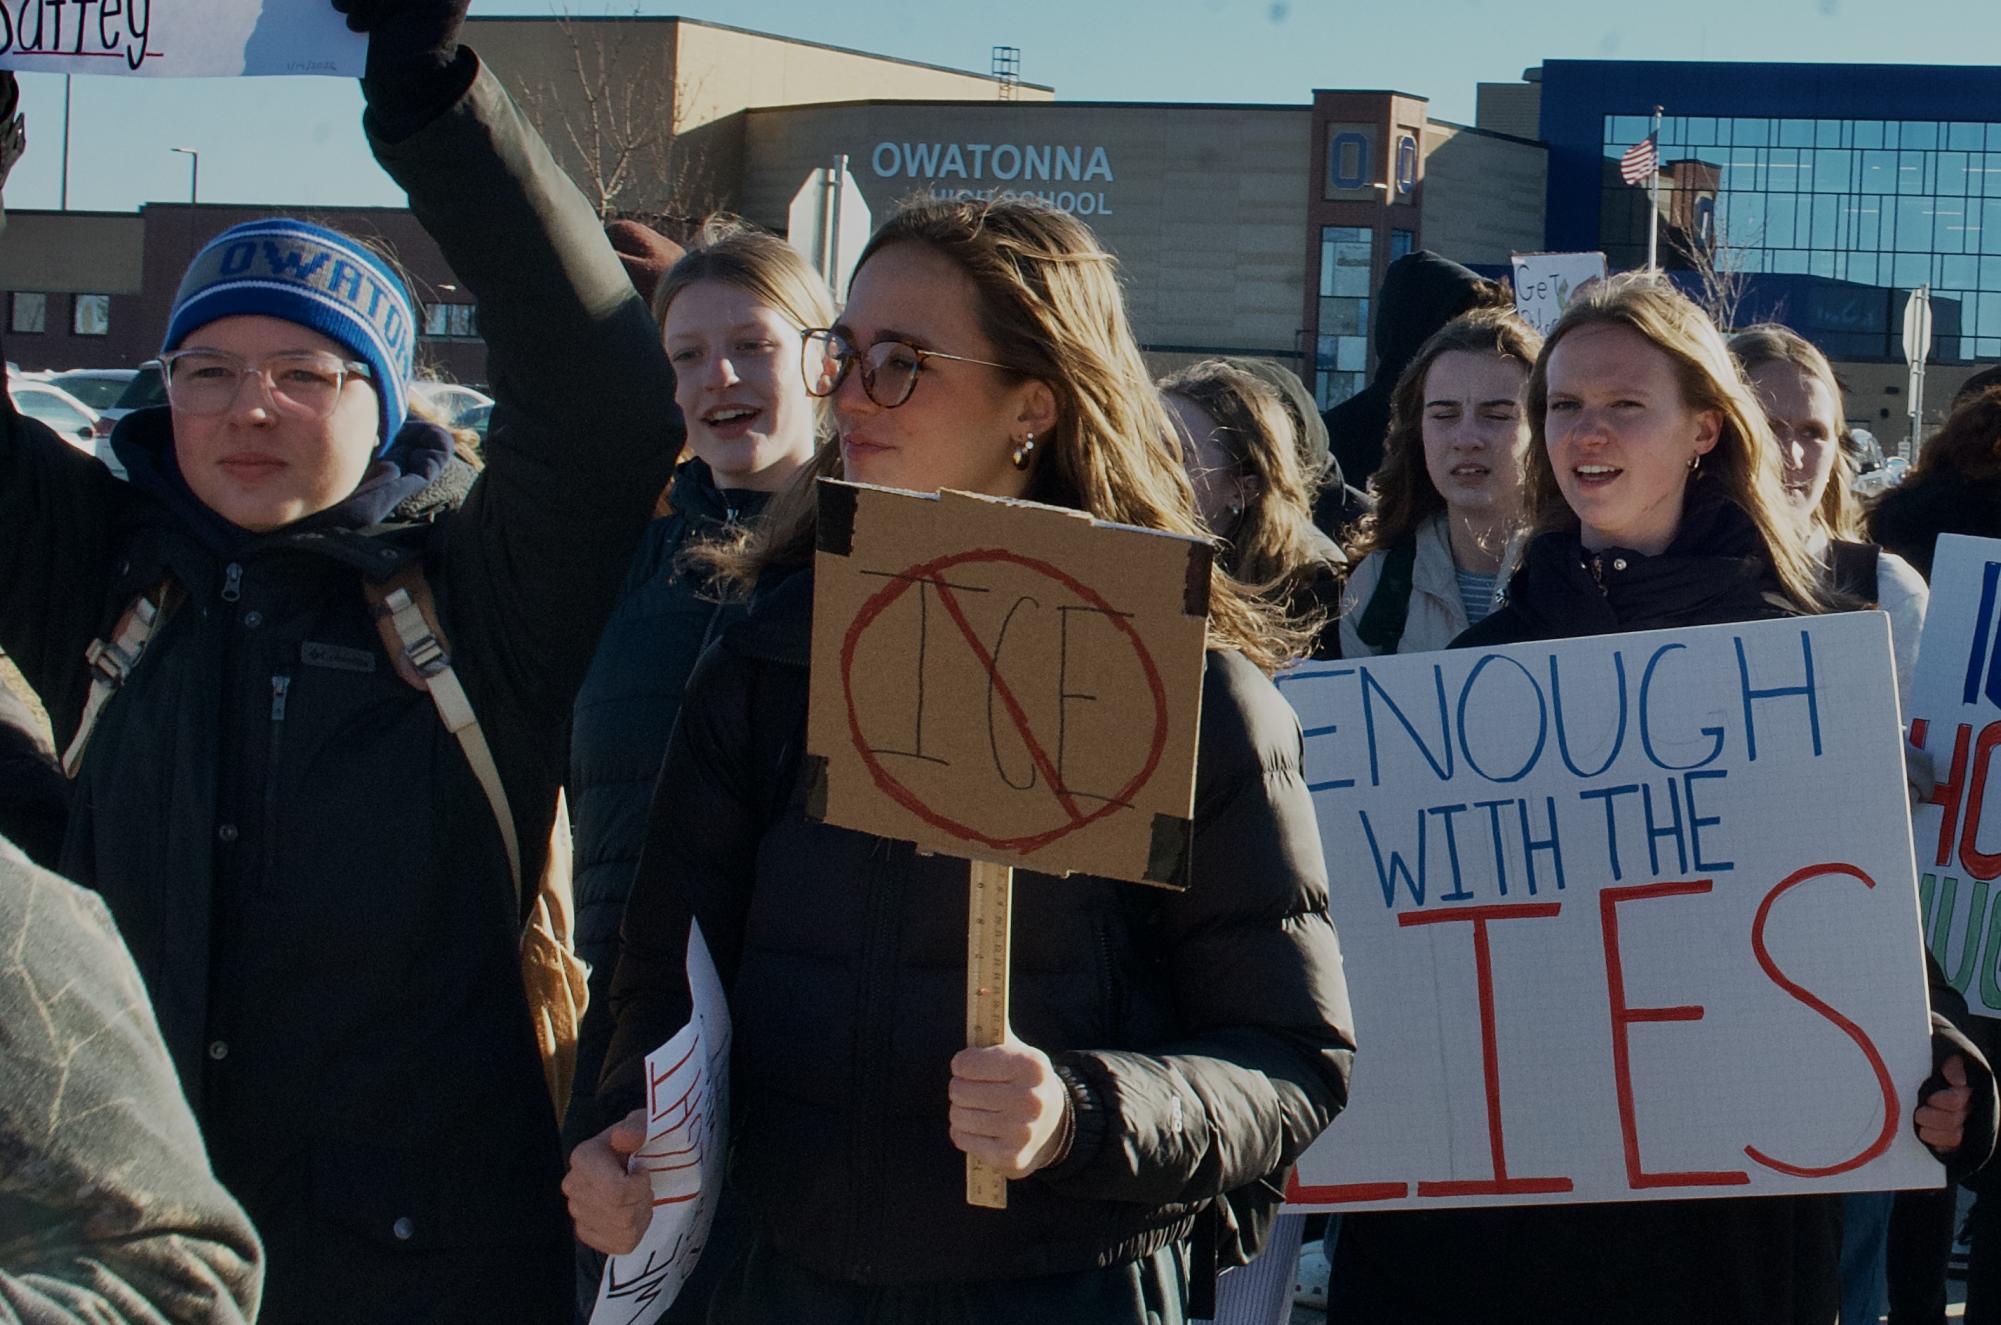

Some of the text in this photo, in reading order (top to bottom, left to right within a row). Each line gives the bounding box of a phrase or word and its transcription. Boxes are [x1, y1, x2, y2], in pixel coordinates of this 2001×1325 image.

[871, 142, 1114, 182] OWATONNA
[860, 569, 1135, 809] ICE
[1276, 631, 1823, 792] ENOUGH
[1359, 770, 1735, 908] WITH THE
